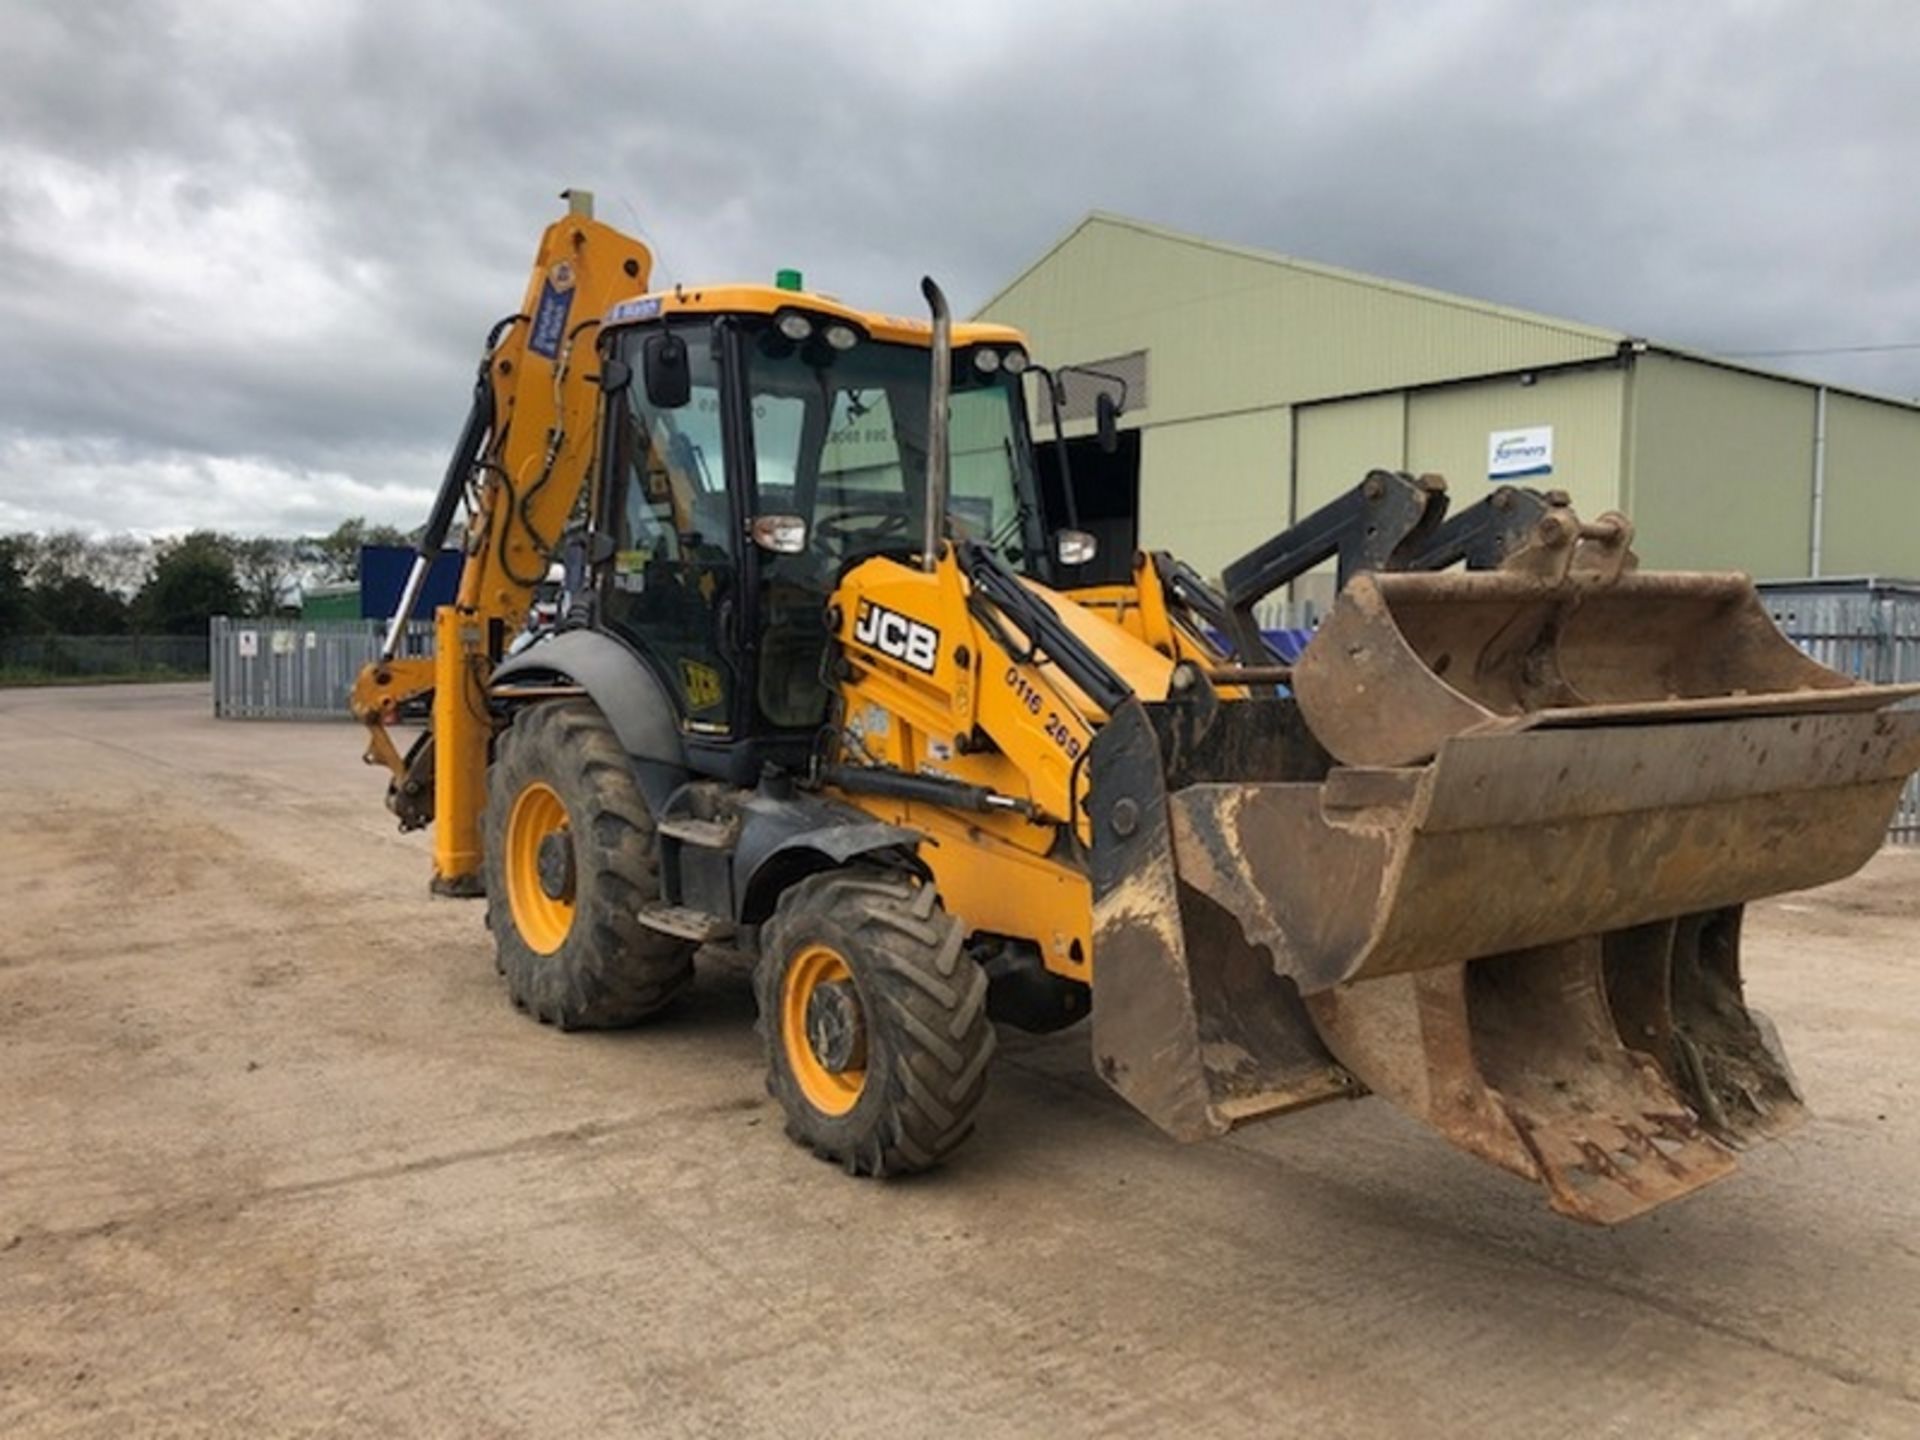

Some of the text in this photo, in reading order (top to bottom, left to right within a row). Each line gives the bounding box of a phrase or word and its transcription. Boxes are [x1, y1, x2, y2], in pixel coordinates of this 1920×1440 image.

[855, 606, 937, 670] JCB
[686, 662, 722, 706] JCB
[1005, 667, 1081, 759] 0116 269
